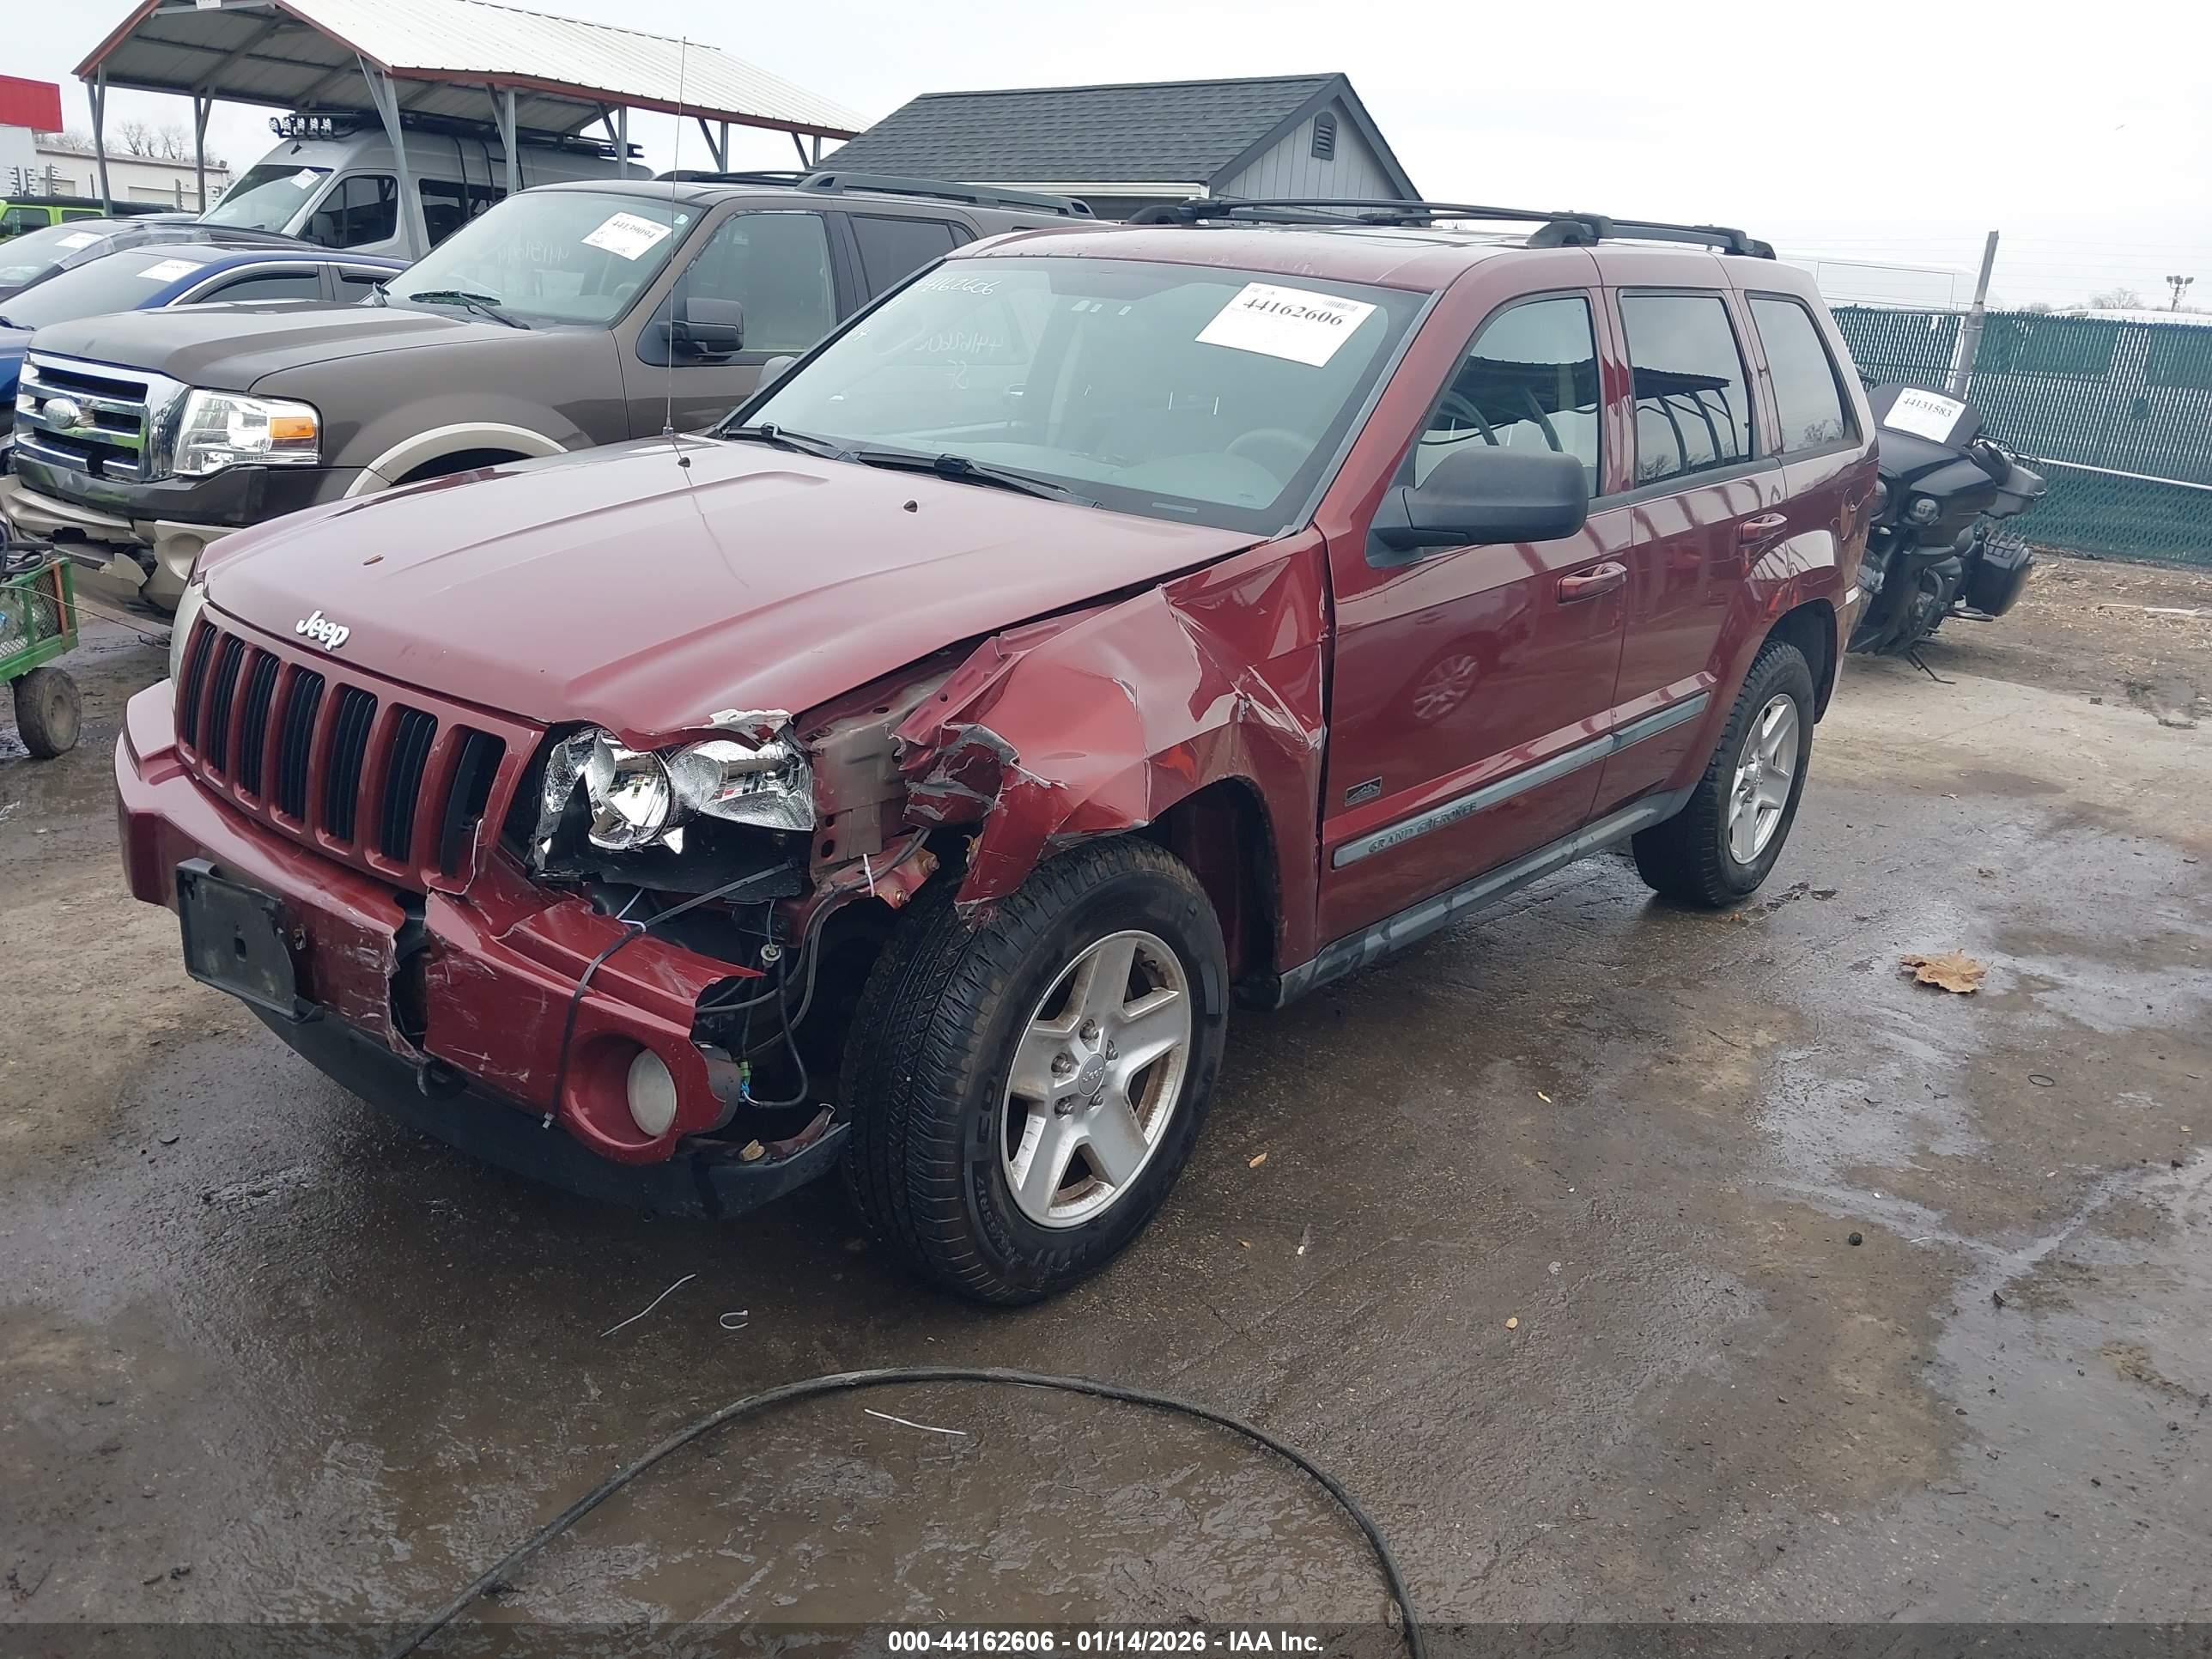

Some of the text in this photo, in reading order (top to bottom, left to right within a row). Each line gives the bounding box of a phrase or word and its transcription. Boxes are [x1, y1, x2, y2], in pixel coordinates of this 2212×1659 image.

[1243, 298, 1346, 326] 44162606
[1903, 398, 1953, 418] 44131583
[295, 610, 350, 651] Jeep
[1369, 802, 1478, 853] GRAND CHEROKEE
